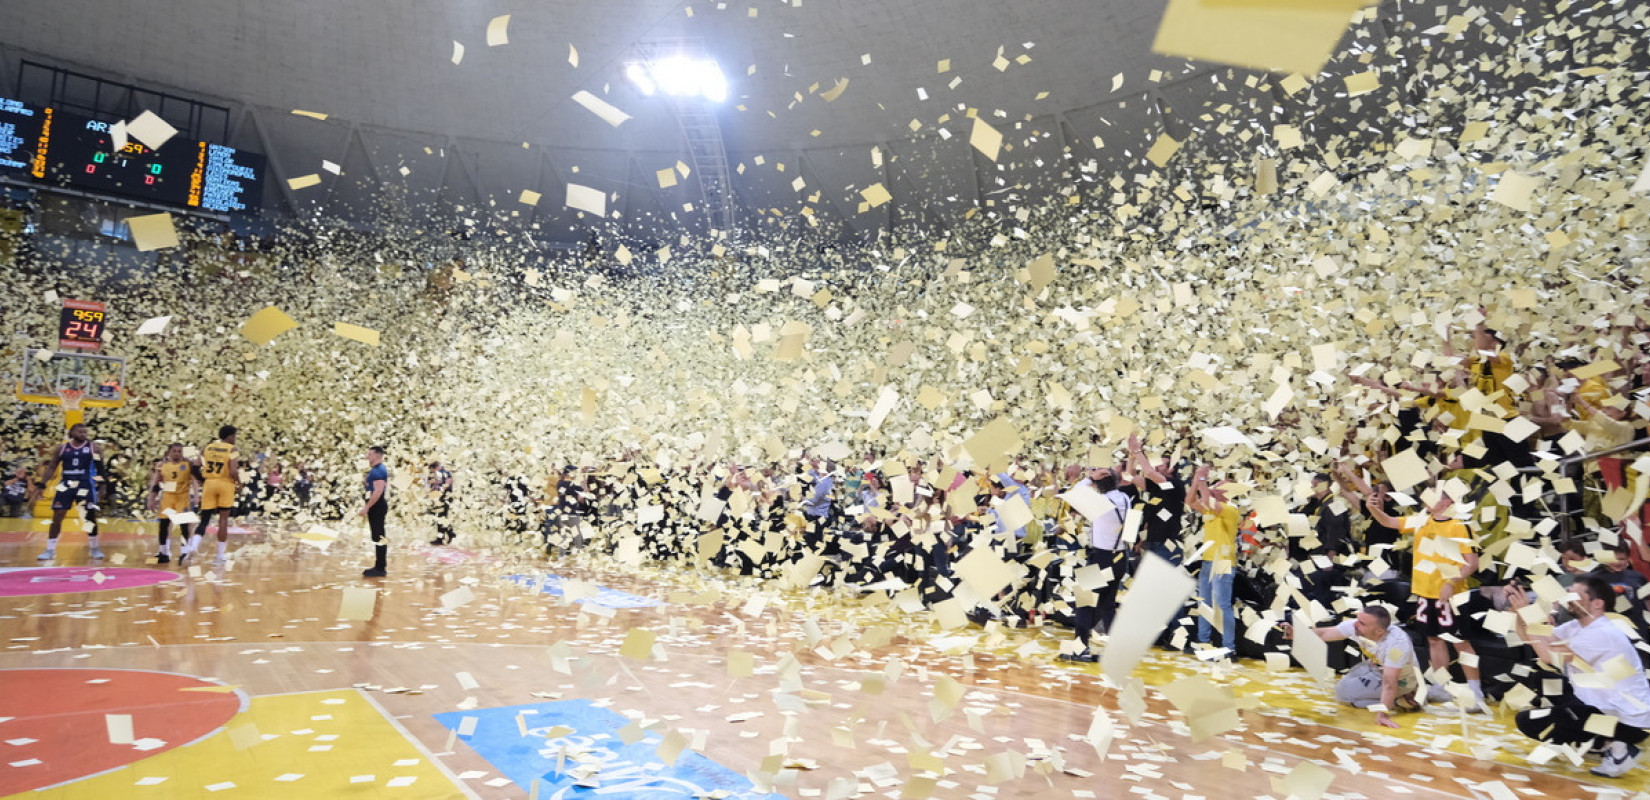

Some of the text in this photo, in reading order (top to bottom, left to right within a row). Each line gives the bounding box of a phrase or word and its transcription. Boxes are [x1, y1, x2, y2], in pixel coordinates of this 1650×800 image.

[86, 164, 96, 173] 0
[151, 163, 162, 175] 0
[145, 175, 155, 185] 0
[65, 321, 98, 338] 24
[206, 461, 224, 474] 37
[171, 471, 177, 479] 3
[1416, 597, 1454, 627] 23
